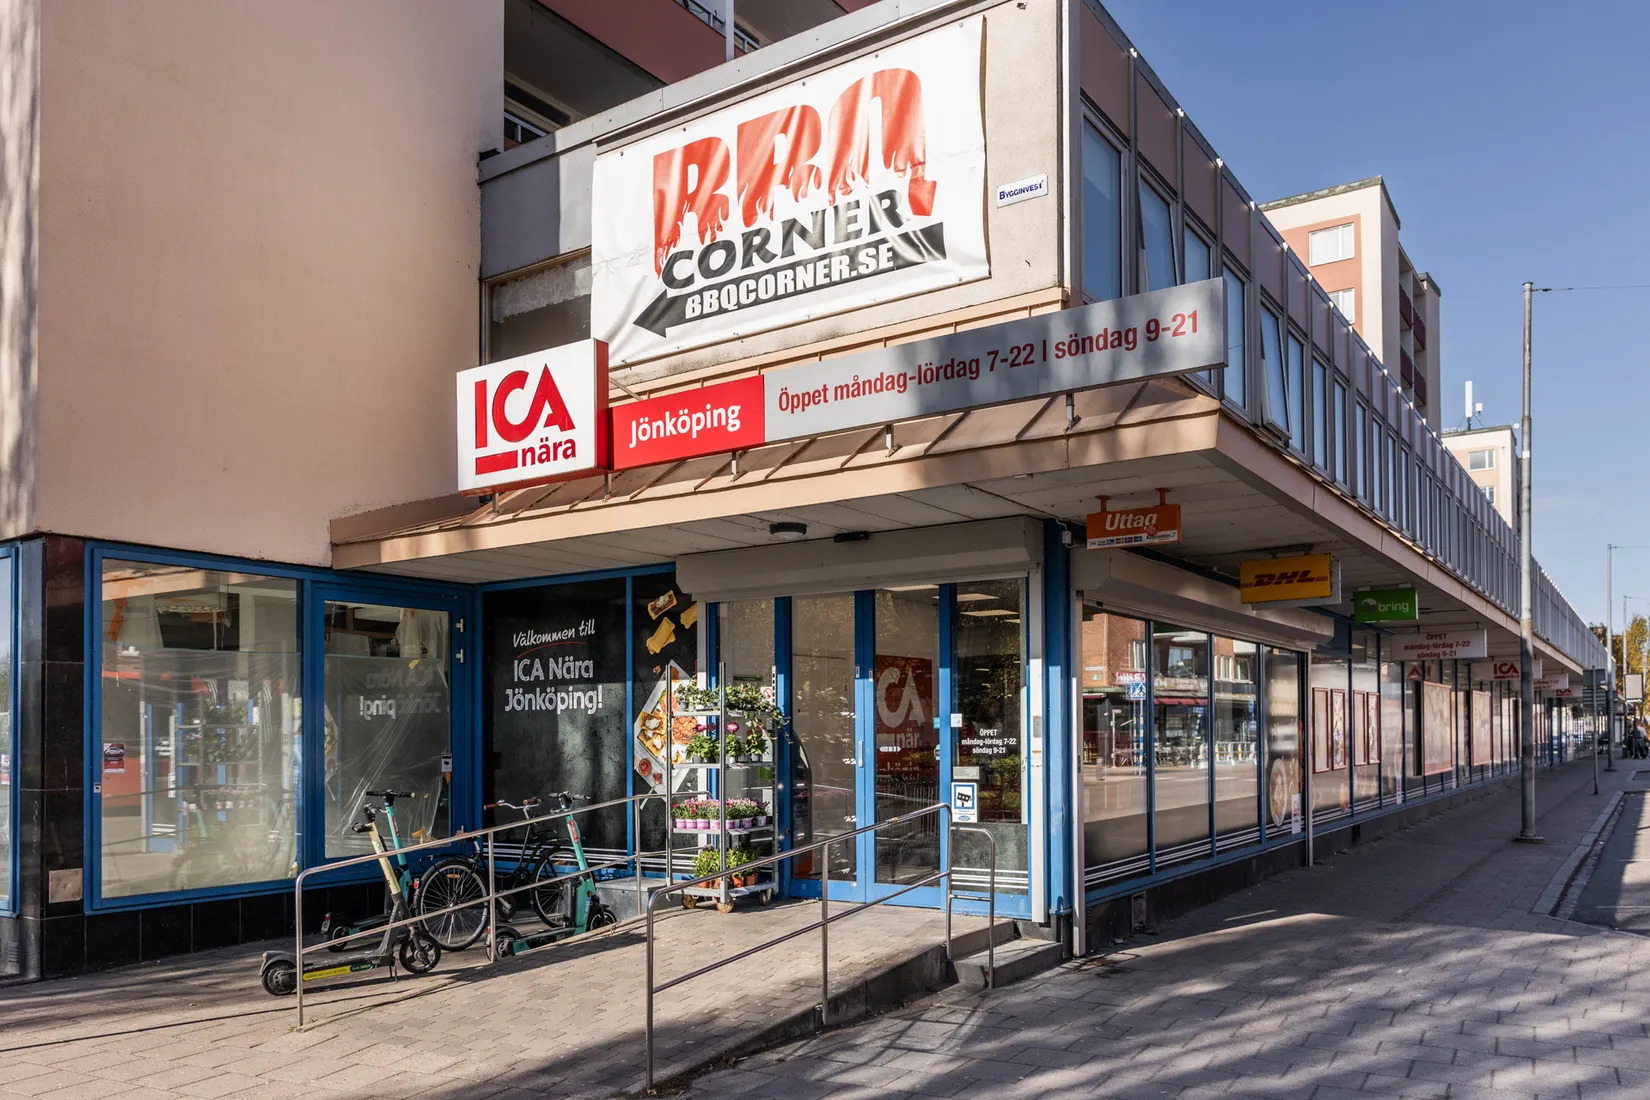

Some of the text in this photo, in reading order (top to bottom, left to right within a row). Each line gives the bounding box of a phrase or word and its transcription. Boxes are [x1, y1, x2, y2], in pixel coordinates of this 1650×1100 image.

[662, 189, 911, 289] CORNER
[685, 243, 894, 319] BBQCORNER.SE
[778, 384, 828, 414] Öppet
[834, 358, 980, 401] måndag-lördag
[987, 343, 1035, 372] 7-22
[1054, 327, 1138, 359] söndag
[1145, 310, 1198, 342] 9-21
[475, 363, 575, 449] ICA
[629, 404, 741, 448] Jönköping
[521, 437, 577, 467] nära
[1253, 569, 1316, 587] DHL
[1378, 601, 1409, 614] bring
[513, 618, 596, 648] Välkommen till
[514, 656, 594, 682] ICA Nära
[1493, 662, 1520, 675] ICA
[505, 685, 603, 715] Jönköping!
[876, 666, 926, 728] CA
[961, 737, 1017, 746] måndag-lördag 7-22
[979, 728, 998, 737] ÖPPET
[972, 747, 993, 755] söndag
